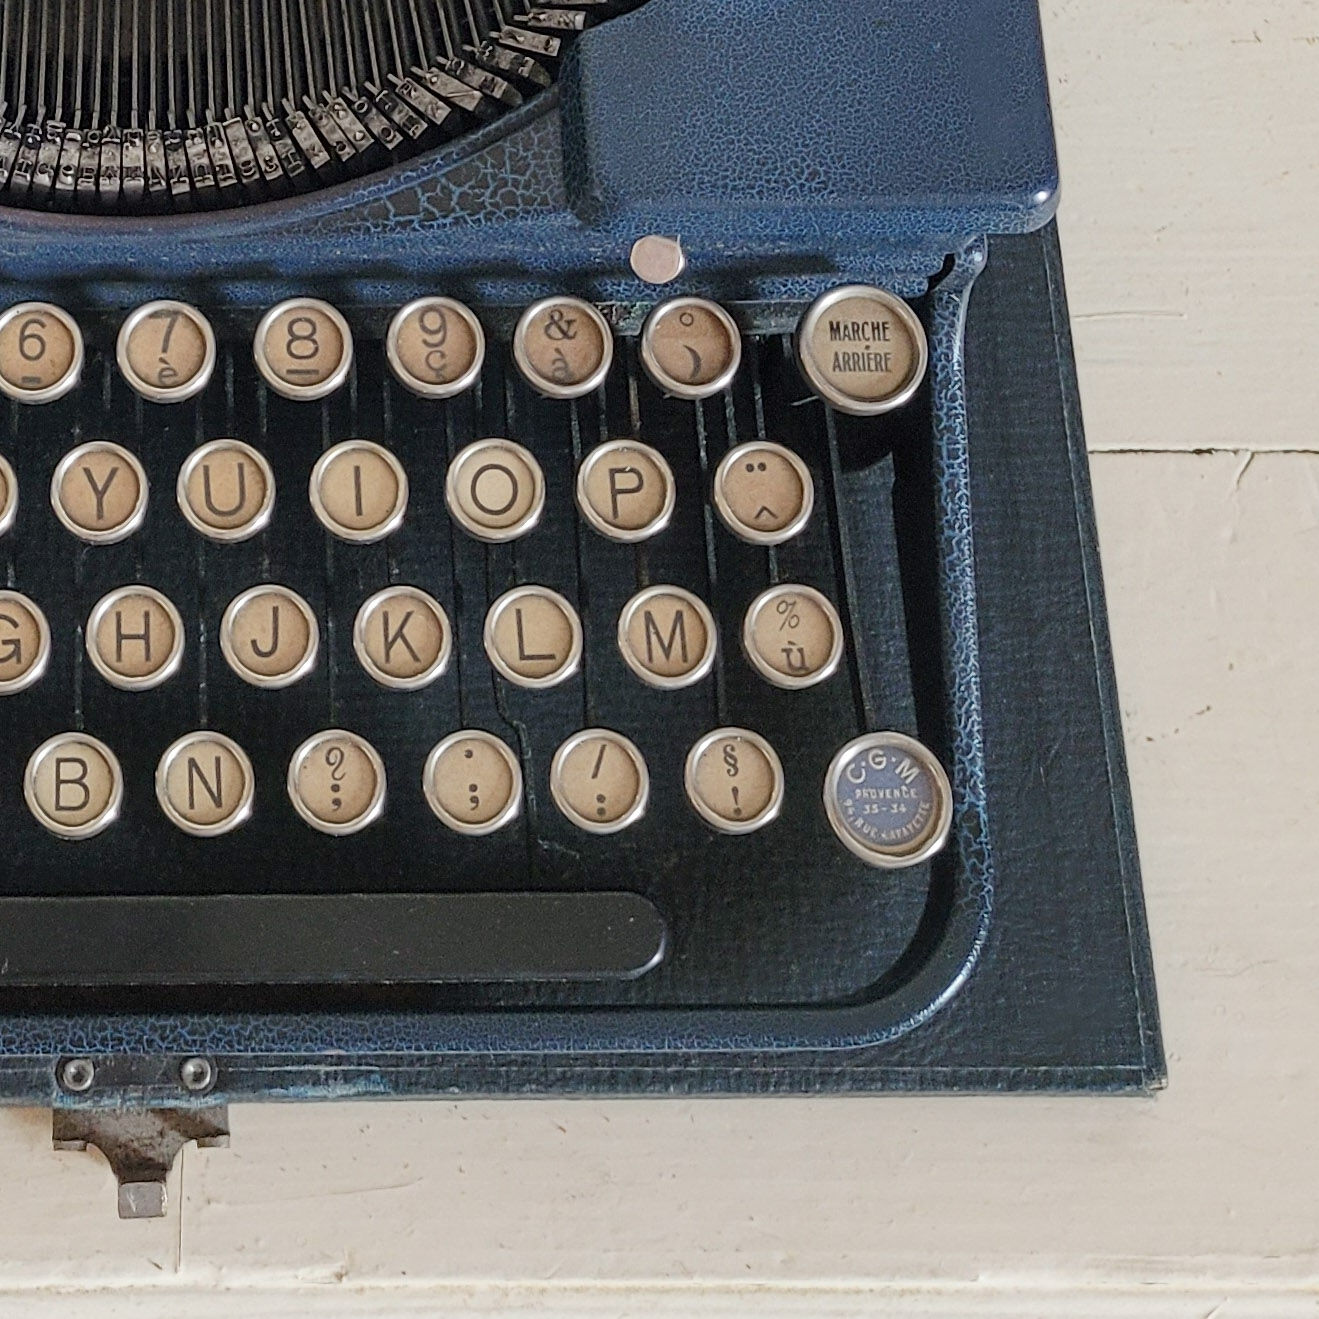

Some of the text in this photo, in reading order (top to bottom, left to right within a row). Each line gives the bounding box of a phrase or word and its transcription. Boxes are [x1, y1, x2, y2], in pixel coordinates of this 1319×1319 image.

[17, 318, 47, 362] 6
[148, 312, 182, 355] 7
[285, 316, 320, 361] 8
[417, 307, 450, 349] 9
[543, 309, 578, 342] &
[828, 320, 891, 342] MARCHE
[157, 357, 177, 384] è
[82, 466, 120, 521] Y
[202, 461, 245, 516] U
[353, 464, 364, 517] I
[469, 462, 519, 516] O
[608, 466, 645, 520] P
[114, 609, 152, 663] H
[249, 604, 280, 659] J
[382, 609, 423, 665] K
[514, 607, 557, 662] L
[643, 609, 689, 665] M
[775, 599, 801, 632] %
[53, 756, 91, 812] B
[187, 755, 224, 811] N
[722, 743, 740, 778] §
[730, 785, 743, 818] !
